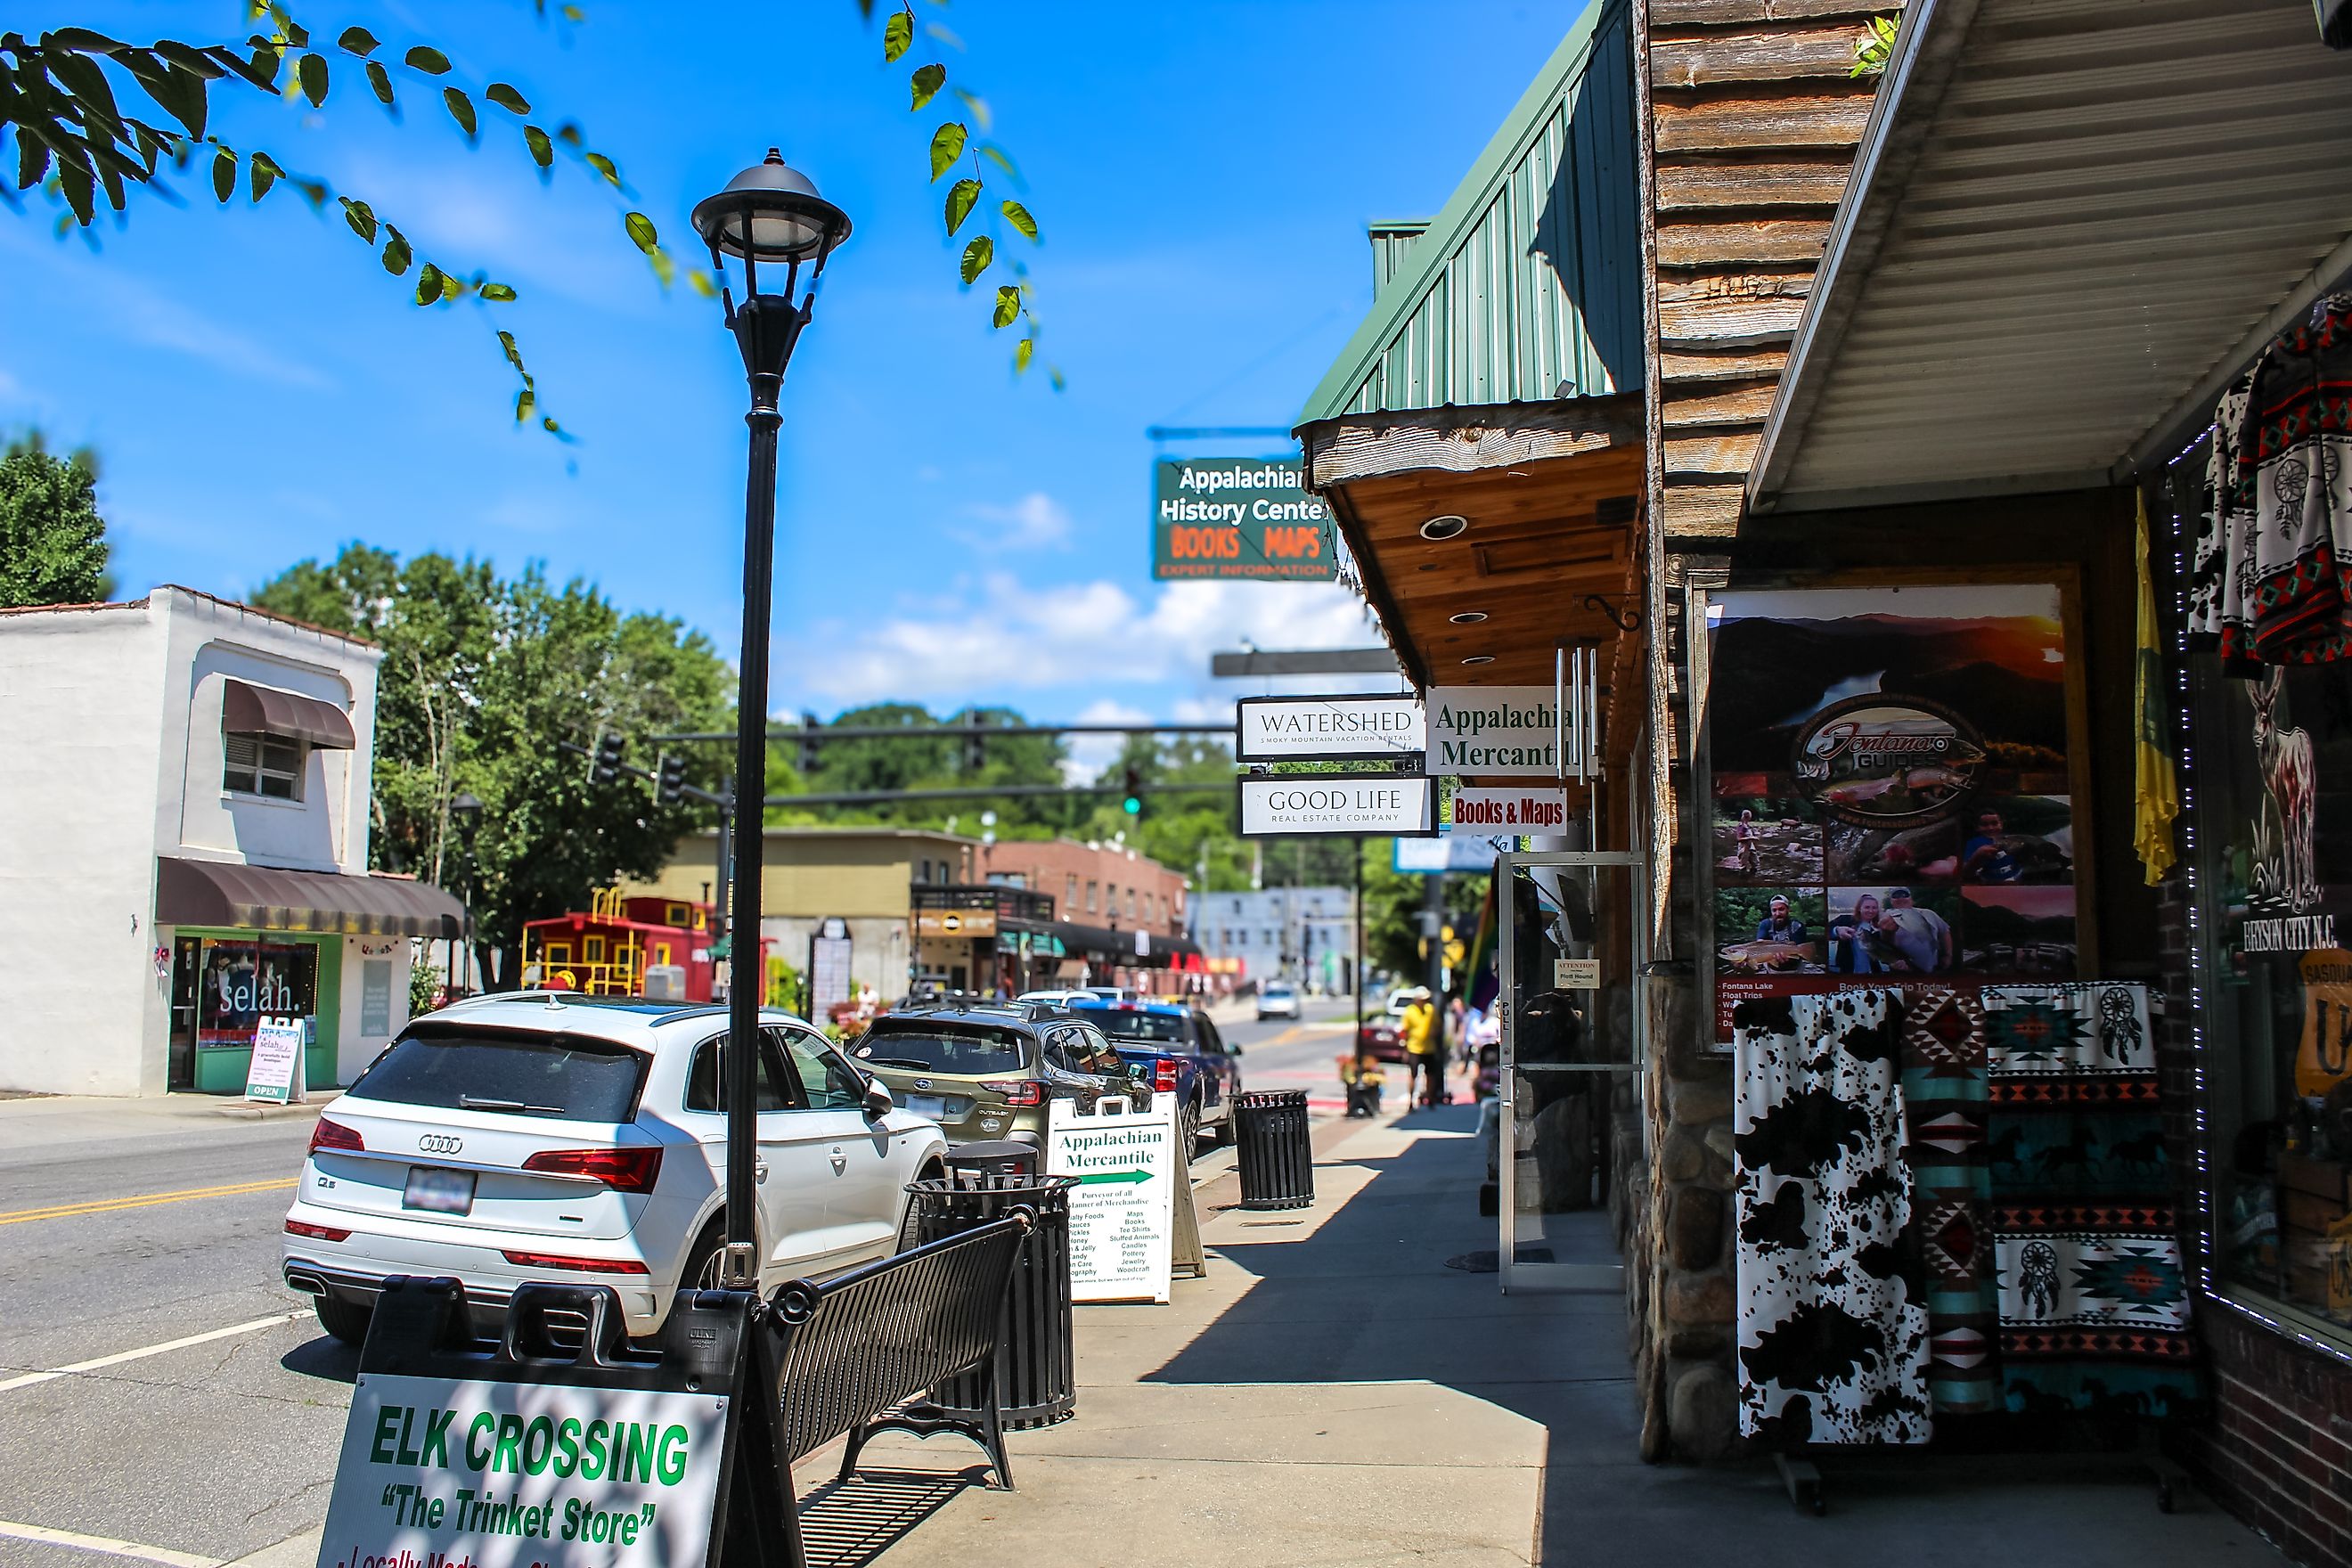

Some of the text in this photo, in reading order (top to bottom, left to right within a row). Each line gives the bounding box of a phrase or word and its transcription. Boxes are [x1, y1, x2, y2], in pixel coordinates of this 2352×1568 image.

[1161, 497, 1247, 527] History
[1170, 525, 1320, 559] BOOKS MAPS
[1160, 564, 1327, 576] EXPERT INFORMATION
[1261, 712, 1411, 733] WATERSHED
[1377, 734, 1412, 742] RENTALS
[1817, 723, 1939, 760] Fontana
[1858, 754, 1939, 768] GUIDES
[1269, 789, 1401, 810] GOOD LIFE
[1271, 813, 1400, 822] REAL ESTATE COMPANY
[1455, 797, 1563, 827] Books & Maps
[2242, 913, 2339, 952] BRYSON CITY N.C.
[2306, 962, 2352, 984] SASQUA
[220, 974, 299, 1012] selah.
[1839, 983, 1950, 992] Book Your Trip Today!
[260, 1040, 279, 1049] selah
[254, 1086, 279, 1096] OPEN
[1059, 1131, 1162, 1151] Appalachian
[1066, 1150, 1155, 1168] Mercantile
[318, 1177, 336, 1189] Q5
[1082, 1191, 1114, 1200] Purveyor
[1105, 1198, 1149, 1206] Merchandise
[1081, 1245, 1097, 1253] Jelly
[370, 1404, 690, 1487] ELK CROSSING
[380, 1482, 657, 1546] “The Trinket Store”
